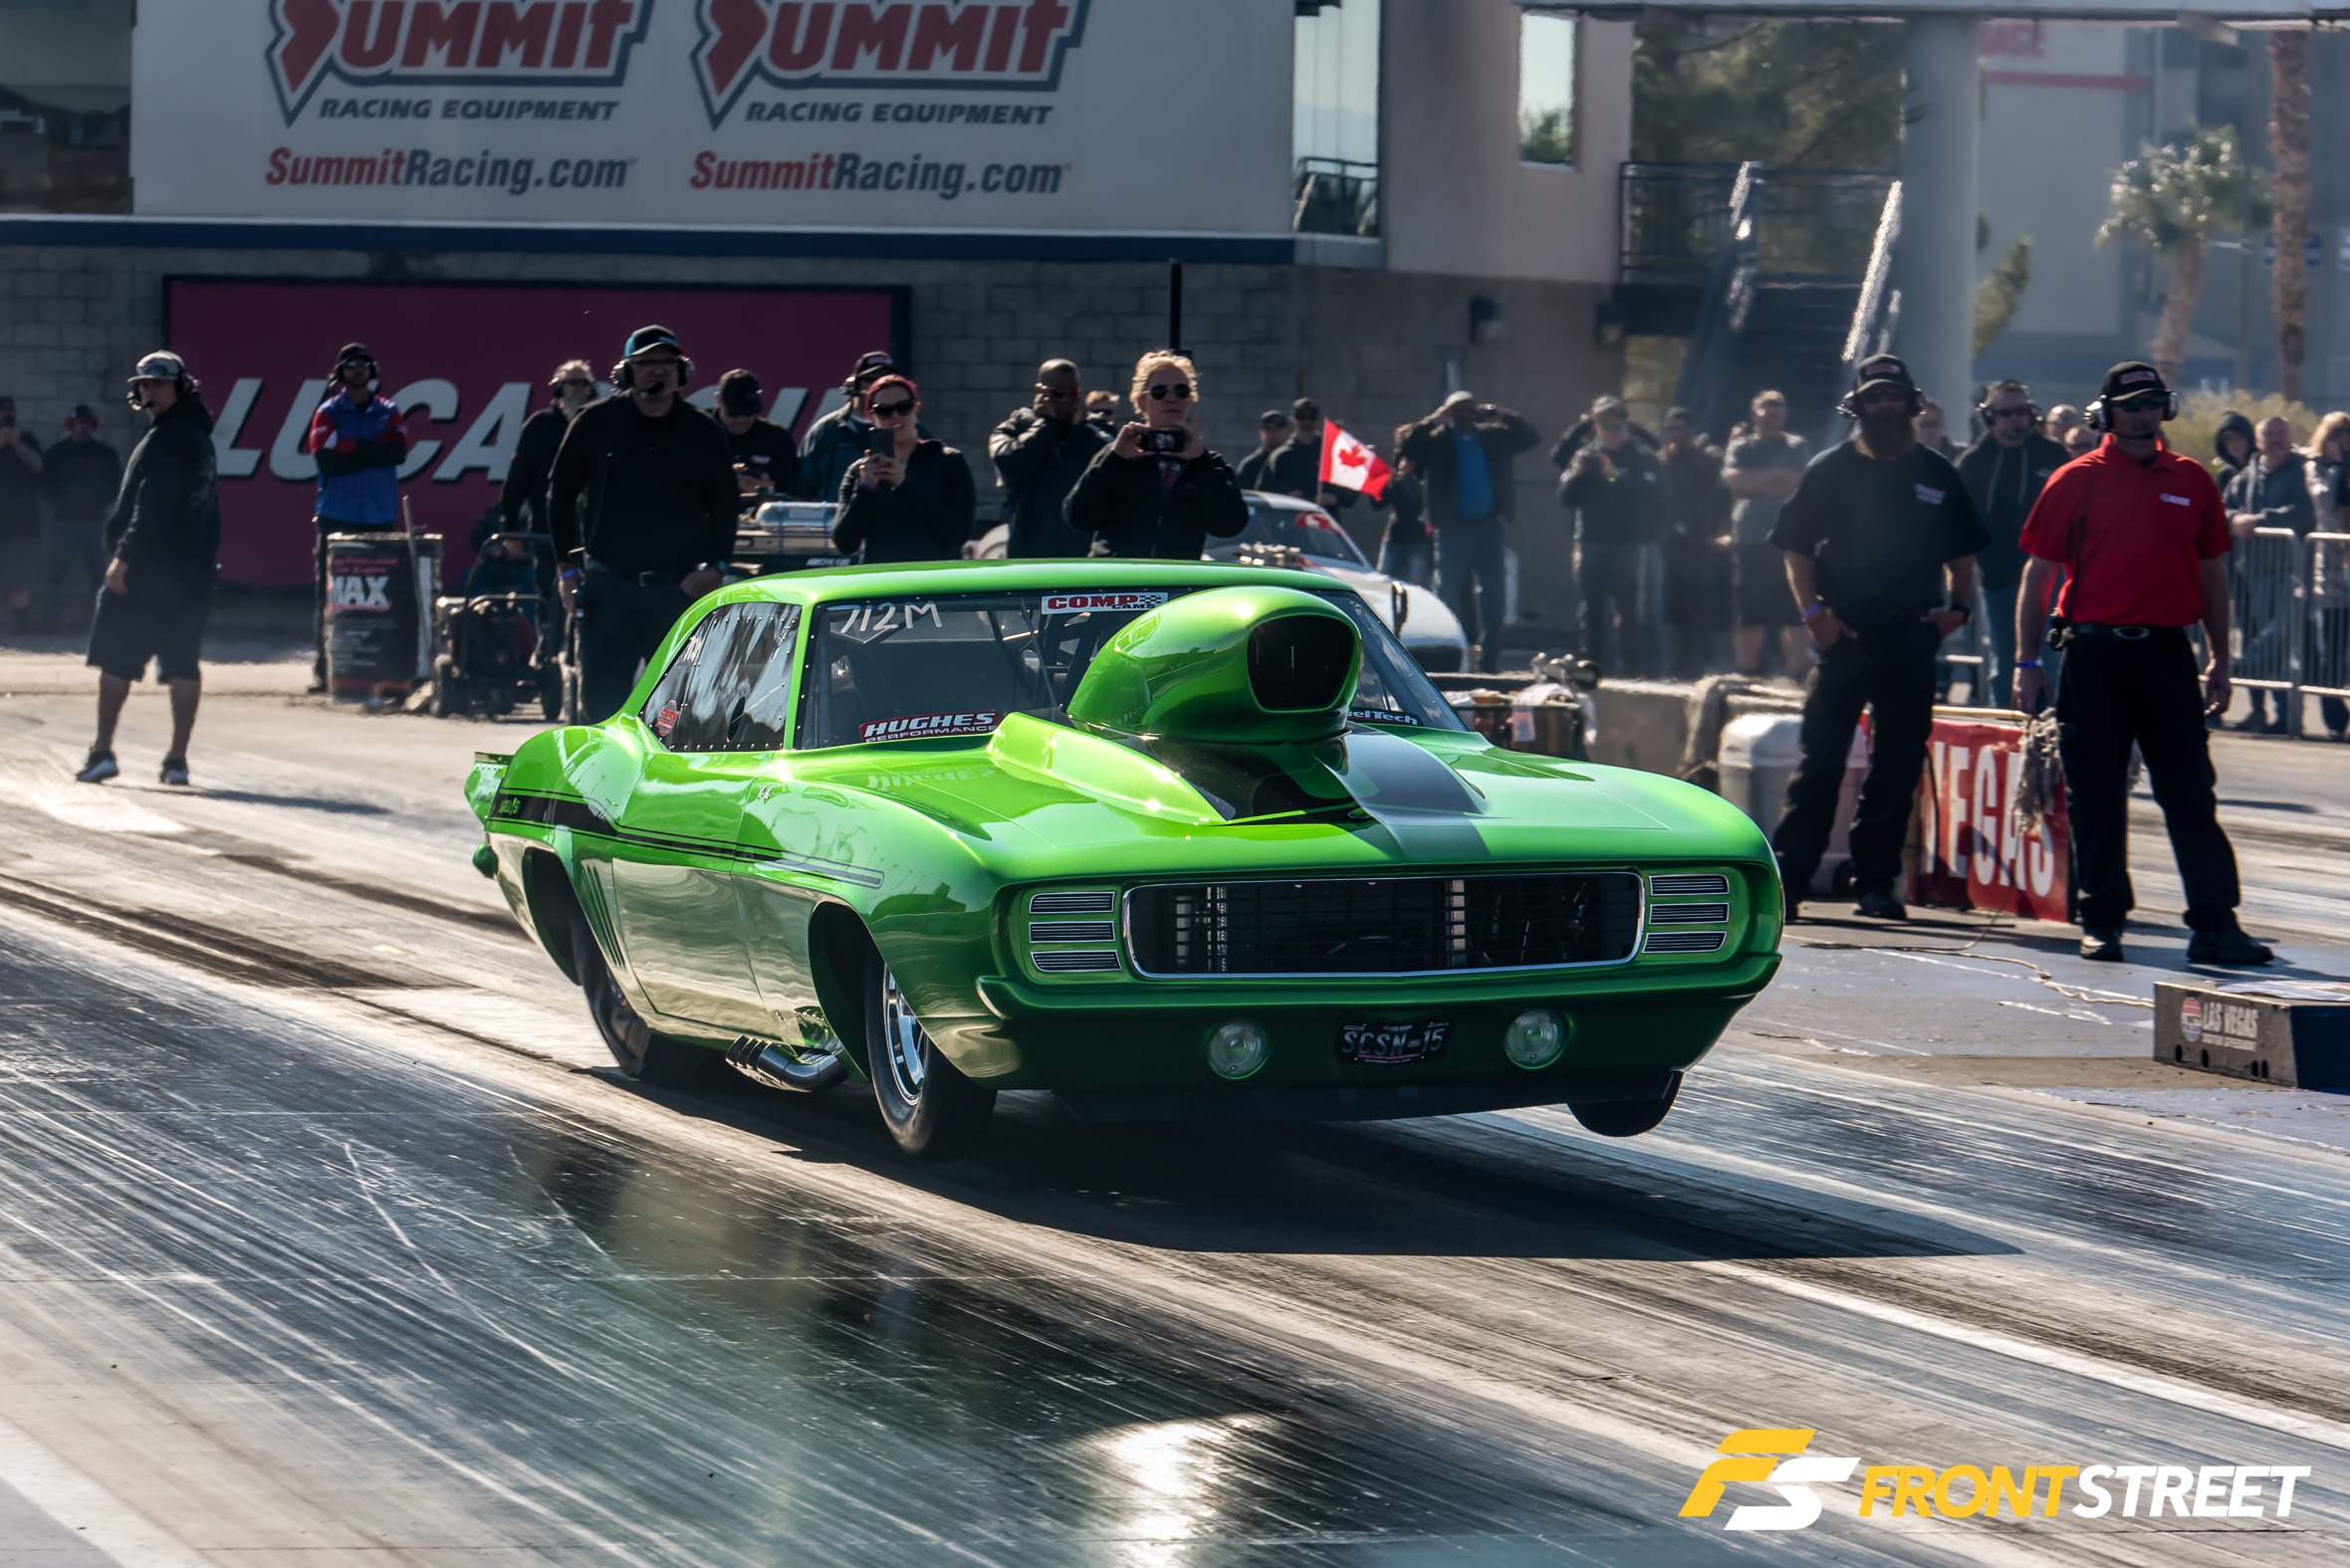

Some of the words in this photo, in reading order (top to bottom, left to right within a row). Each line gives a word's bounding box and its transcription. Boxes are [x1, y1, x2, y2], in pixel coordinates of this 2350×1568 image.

[319, 98, 432, 119] RACING
[441, 99, 619, 121] EQUIPMENT
[746, 101, 862, 122] RACING
[872, 103, 1054, 125] EQUIPMENT
[265, 146, 630, 196] SummitRacing.com
[690, 149, 1064, 200] SummitRacing.com
[1048, 594, 1138, 610] COMP
[827, 601, 943, 634] 712M
[863, 713, 996, 738] HUGHES
[865, 725, 997, 744] PERFORMANCE
[2202, 1002, 2223, 1032] LAS
[2224, 1005, 2258, 1039] VEGAS
